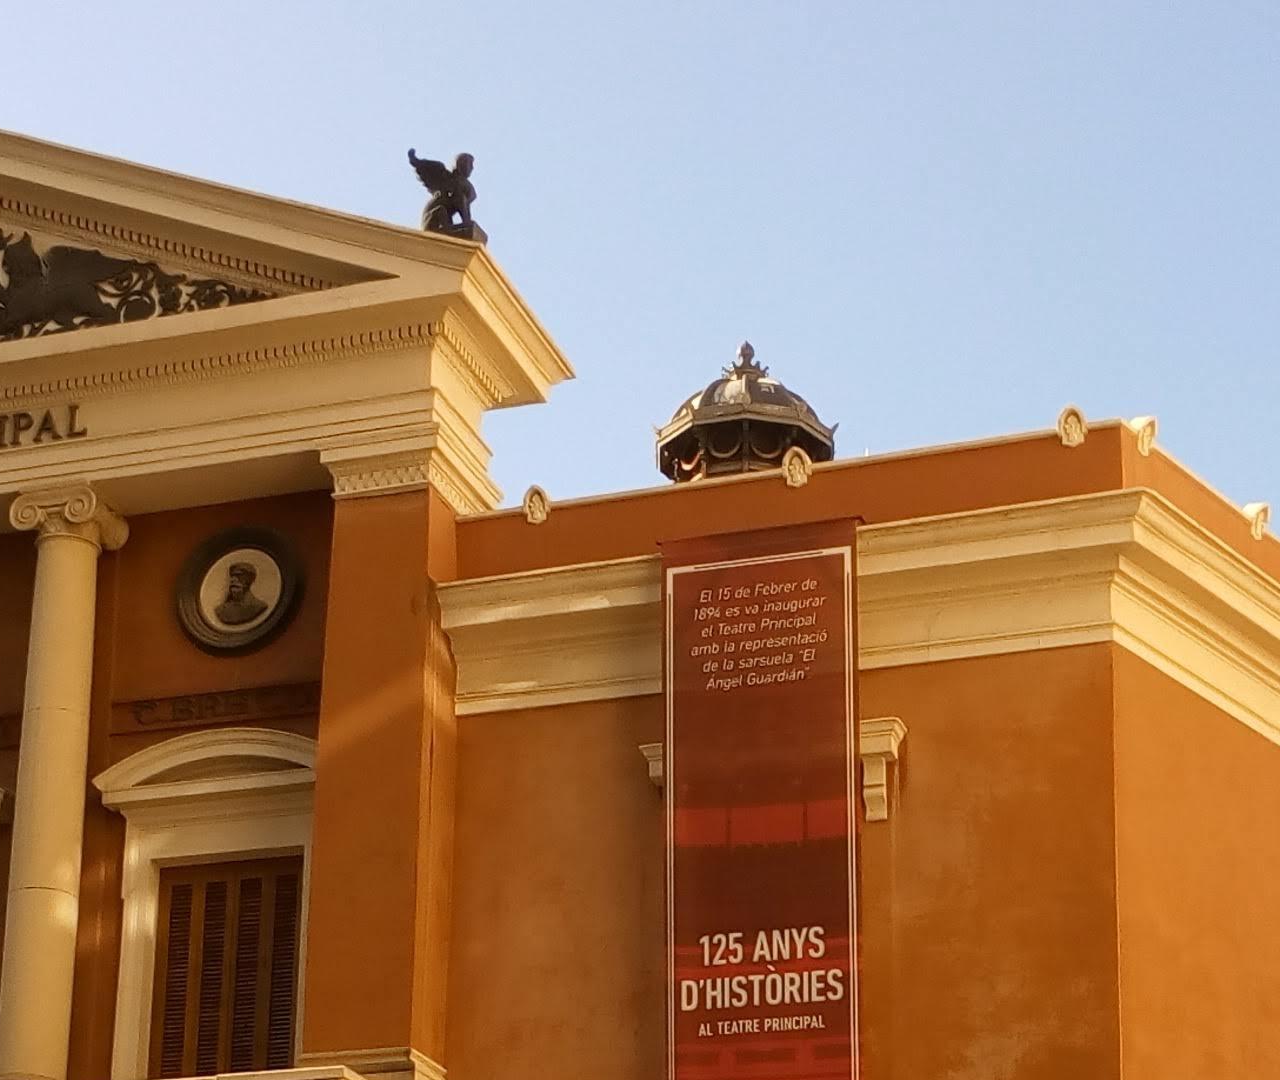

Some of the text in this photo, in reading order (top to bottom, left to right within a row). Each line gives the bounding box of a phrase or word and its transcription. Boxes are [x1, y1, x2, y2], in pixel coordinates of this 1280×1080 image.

[699, 578, 818, 604] El 15 de Febrer de
[693, 595, 827, 622] 1894 es va inaugurar
[701, 612, 817, 639] el Teatre Principal
[691, 629, 829, 658] amb la representació
[702, 657, 719, 674] de
[723, 656, 735, 671] la
[738, 650, 794, 670] sarsuela
[706, 673, 744, 693] Ángel
[698, 925, 826, 967] 125 ANYS
[680, 964, 844, 1012] D'HISTÒRIES
[698, 1014, 826, 1037] AL TEATRE PRINCIPAL
